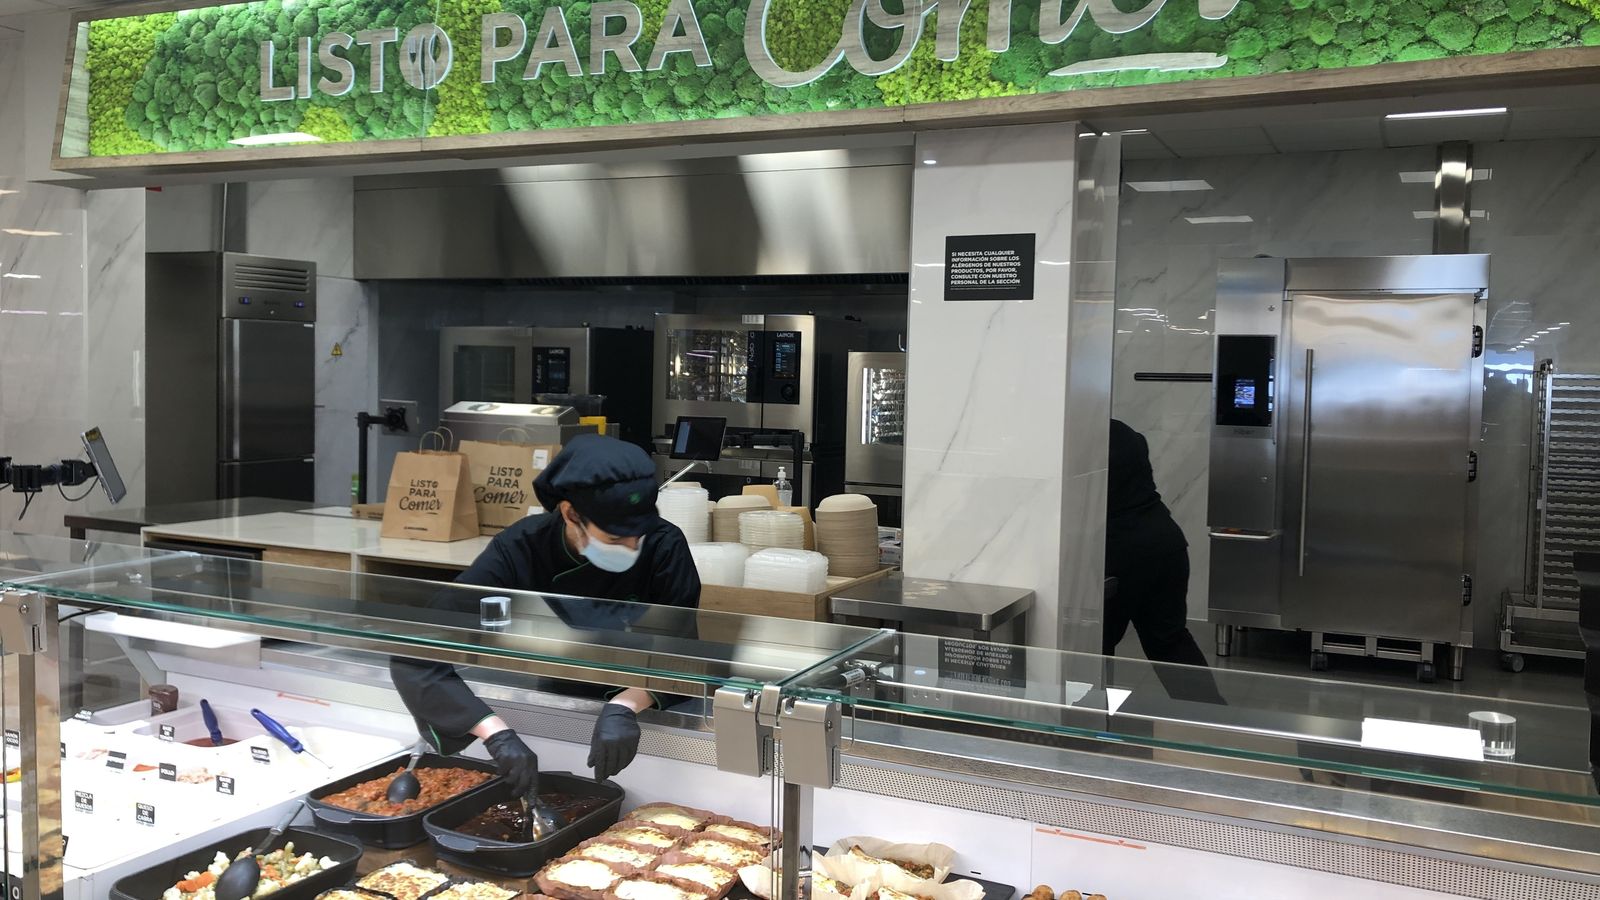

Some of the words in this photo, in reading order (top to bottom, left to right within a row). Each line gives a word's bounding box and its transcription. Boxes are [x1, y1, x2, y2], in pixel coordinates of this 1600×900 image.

[260, 23, 453, 102] LISTO
[480, 0, 713, 83] PARA
[744, 0, 1240, 88] Com
[490, 466, 523, 478] LISTO
[410, 479, 439, 488] LISTO
[487, 476, 520, 489] PARA
[409, 487, 437, 498] PARA
[473, 486, 529, 505] Comer
[399, 496, 443, 511] Comer
